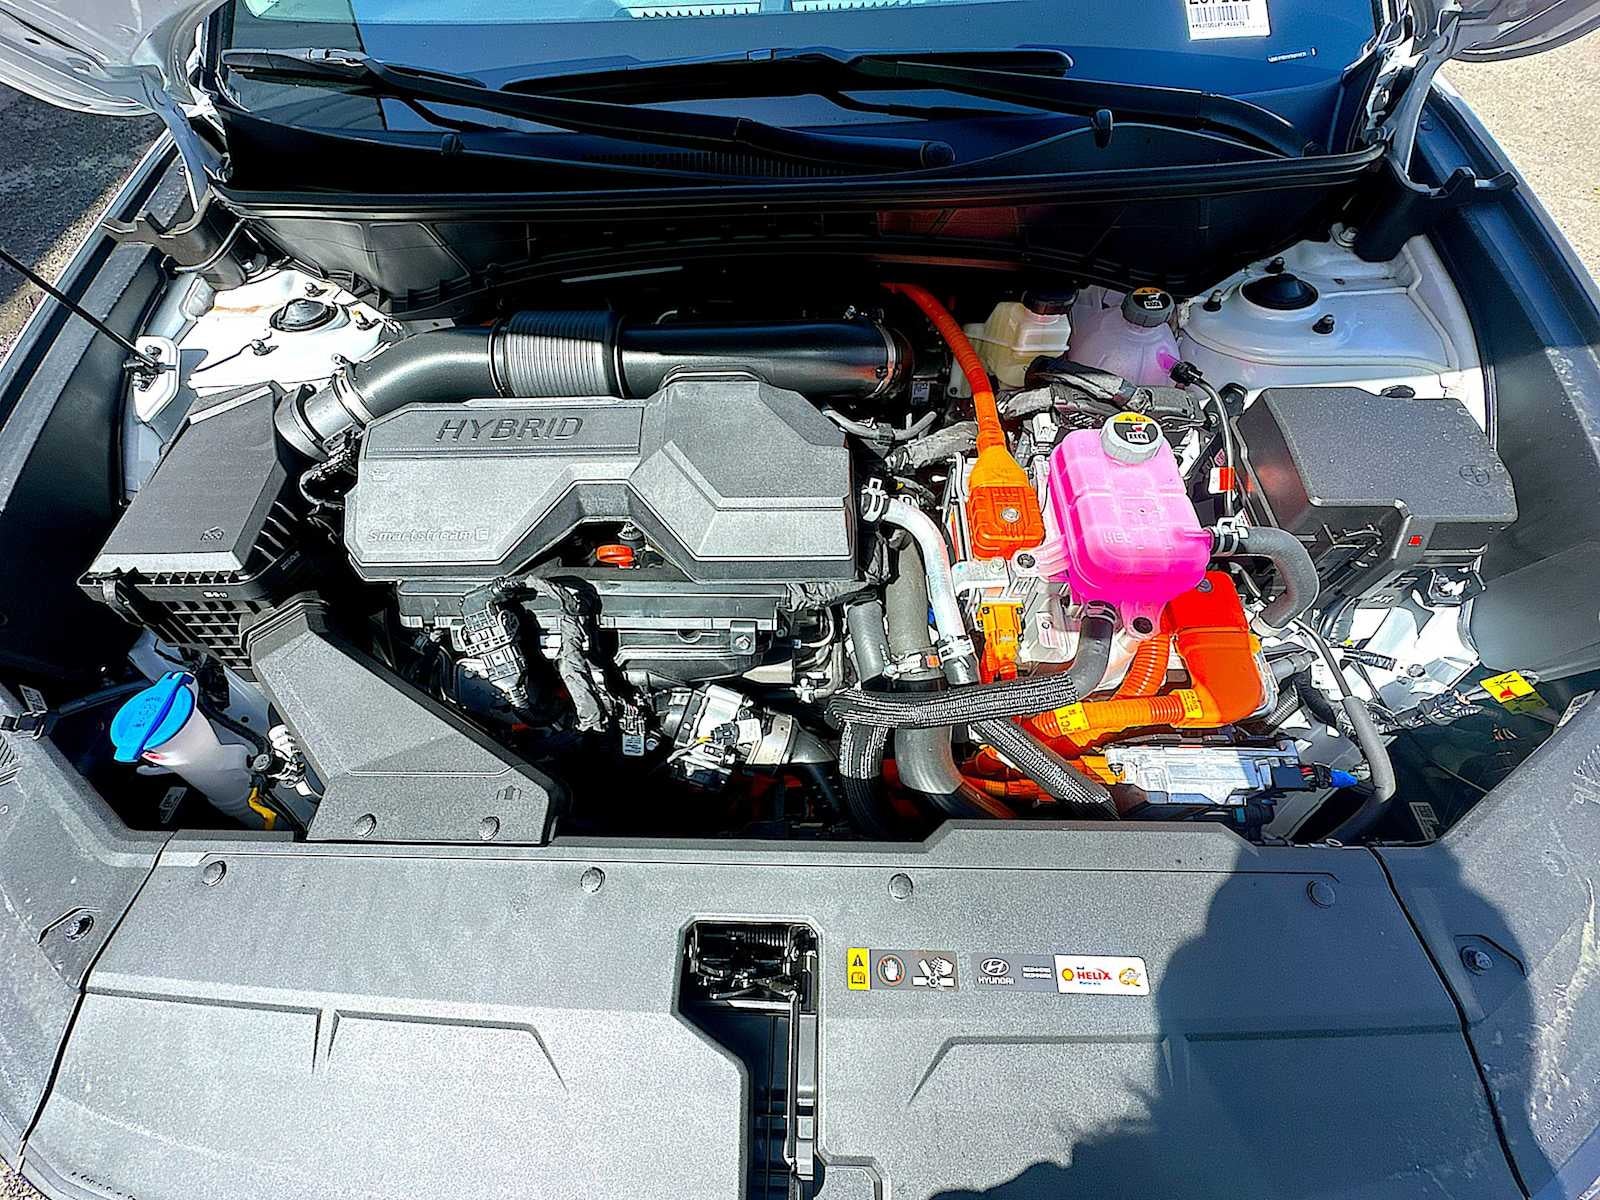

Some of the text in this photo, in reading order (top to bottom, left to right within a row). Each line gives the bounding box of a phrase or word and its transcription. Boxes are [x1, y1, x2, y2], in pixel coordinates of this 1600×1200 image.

[435, 417, 584, 442] HYBRID
[367, 529, 474, 542] Smartstream
[978, 976, 1015, 985] HYUNDAI
[1077, 970, 1112, 980] HELIX
